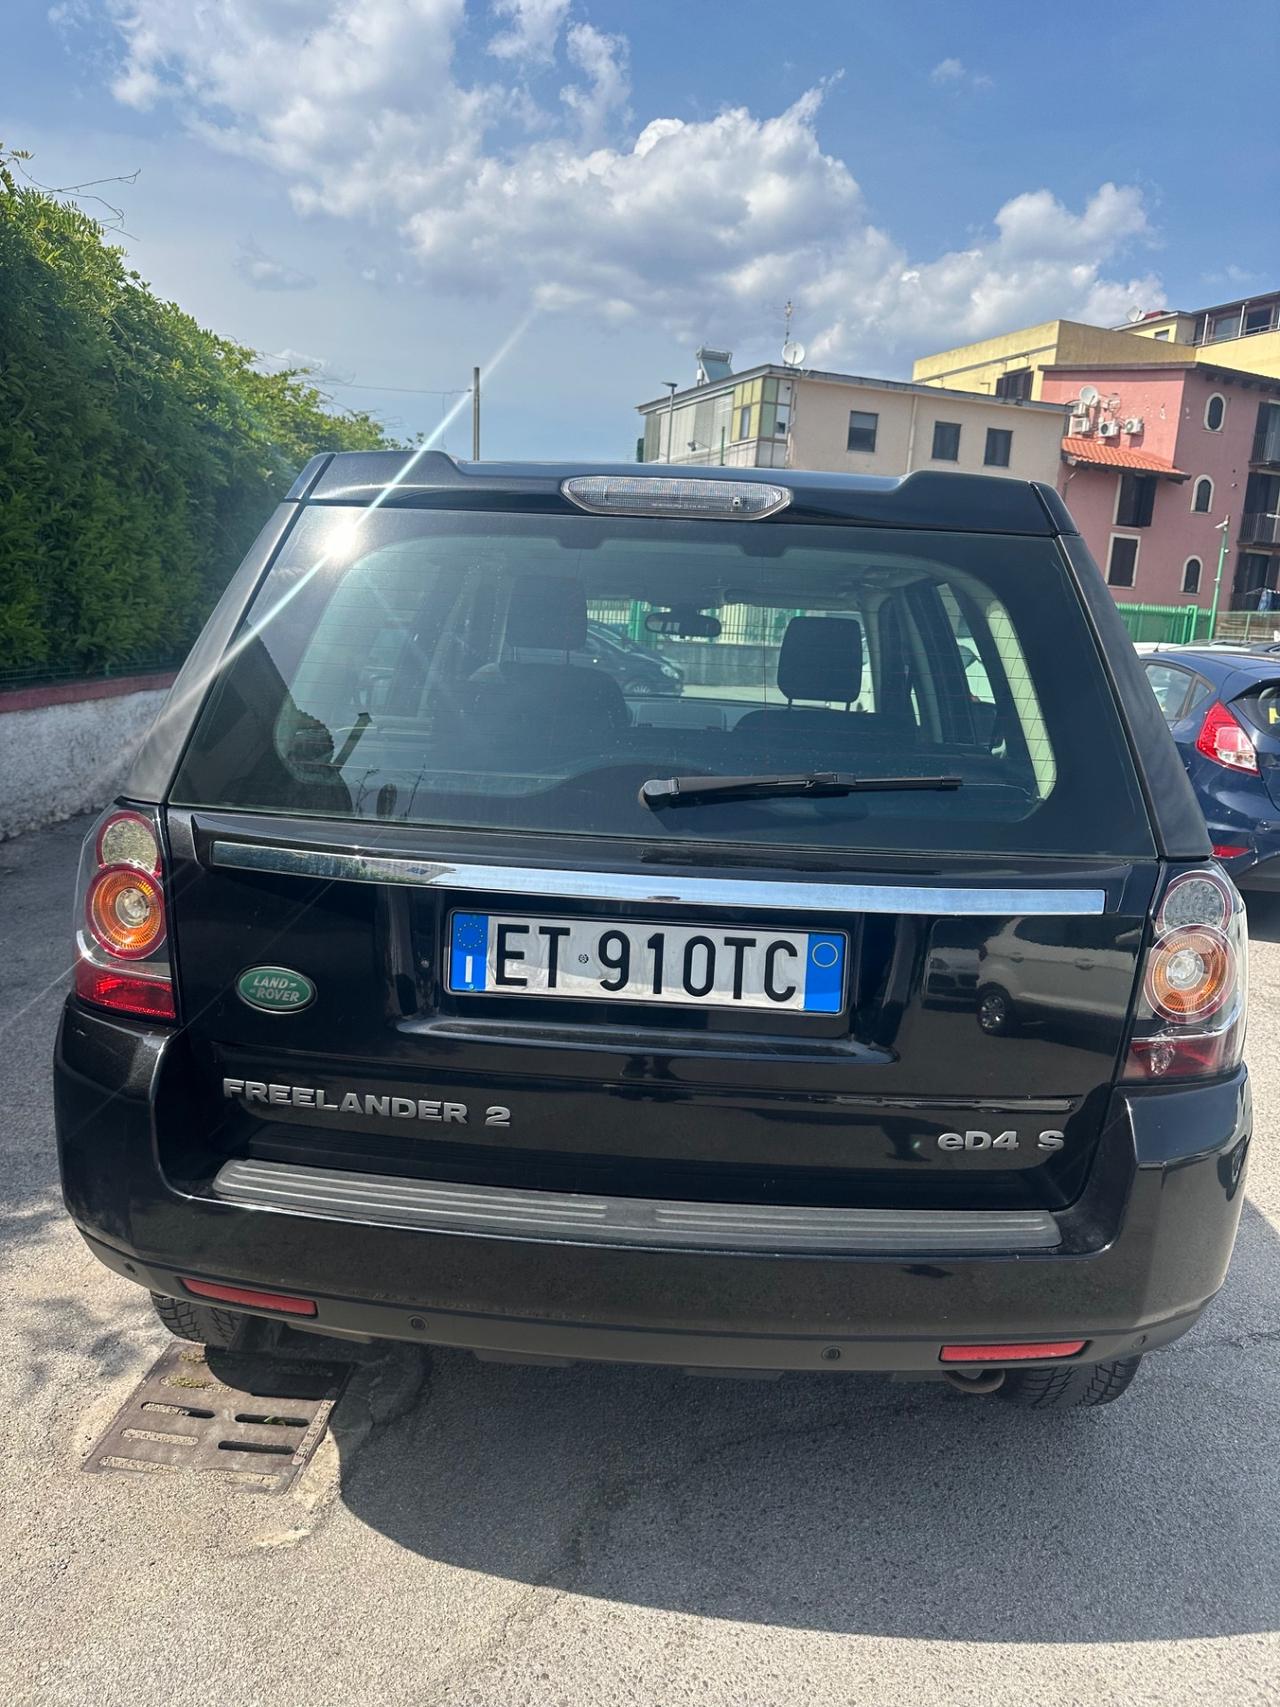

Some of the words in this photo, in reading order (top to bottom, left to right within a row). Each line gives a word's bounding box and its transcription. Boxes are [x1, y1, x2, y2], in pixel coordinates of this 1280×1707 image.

[495, 923, 571, 988] ET
[598, 929, 799, 1003] 910TC
[222, 1077, 468, 1125] FREELANDER
[484, 1106, 512, 1128] 2
[937, 1130, 1020, 1151] eD4
[1037, 1130, 1065, 1151] S
